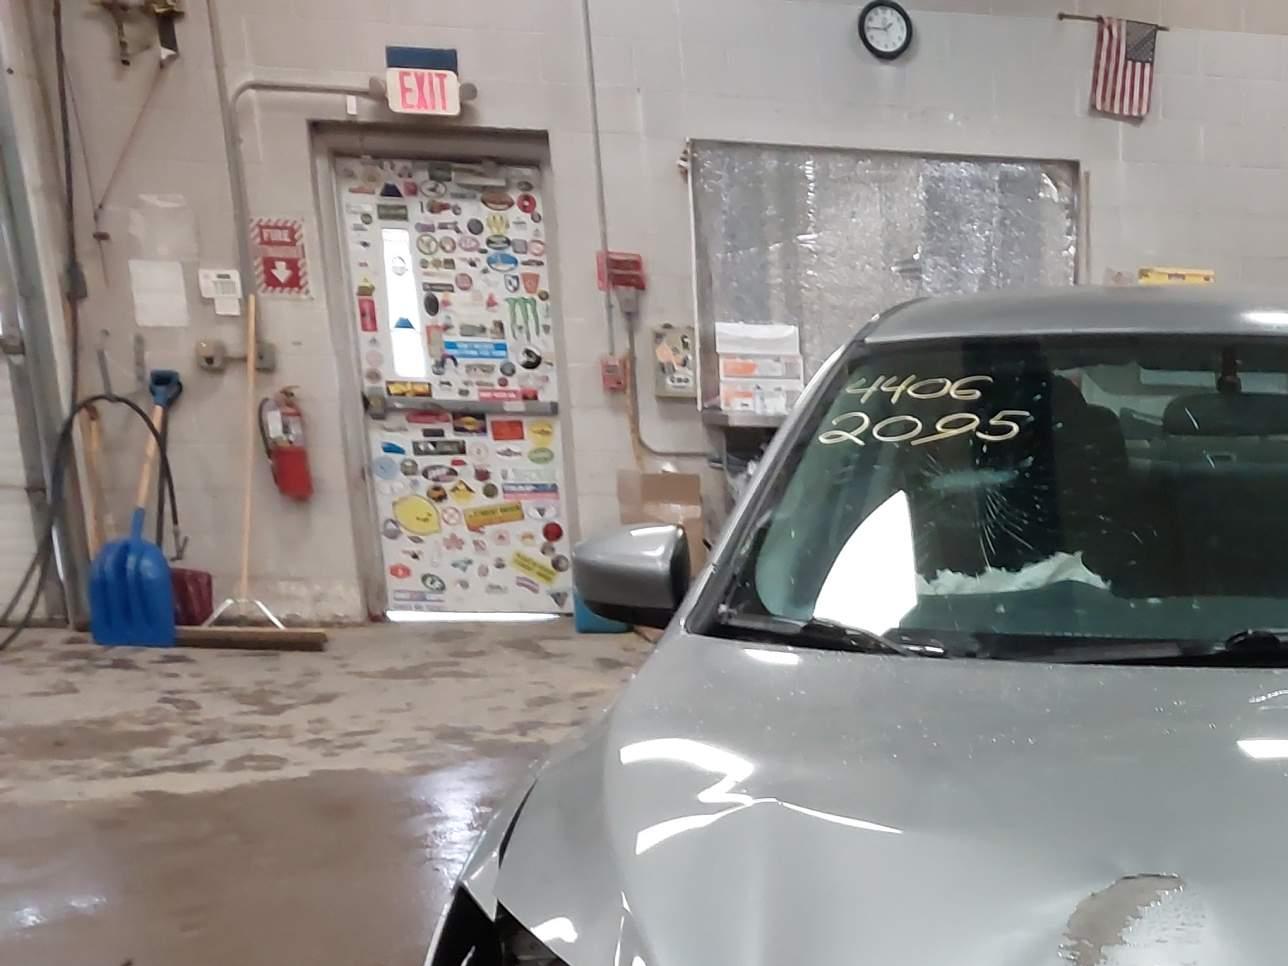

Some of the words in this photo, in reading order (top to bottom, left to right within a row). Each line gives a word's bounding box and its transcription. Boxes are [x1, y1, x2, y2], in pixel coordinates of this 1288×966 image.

[398, 70, 448, 112] EXIT
[262, 228, 291, 242] FIRE
[846, 374, 993, 405] 4406
[818, 410, 1031, 446] 2095
